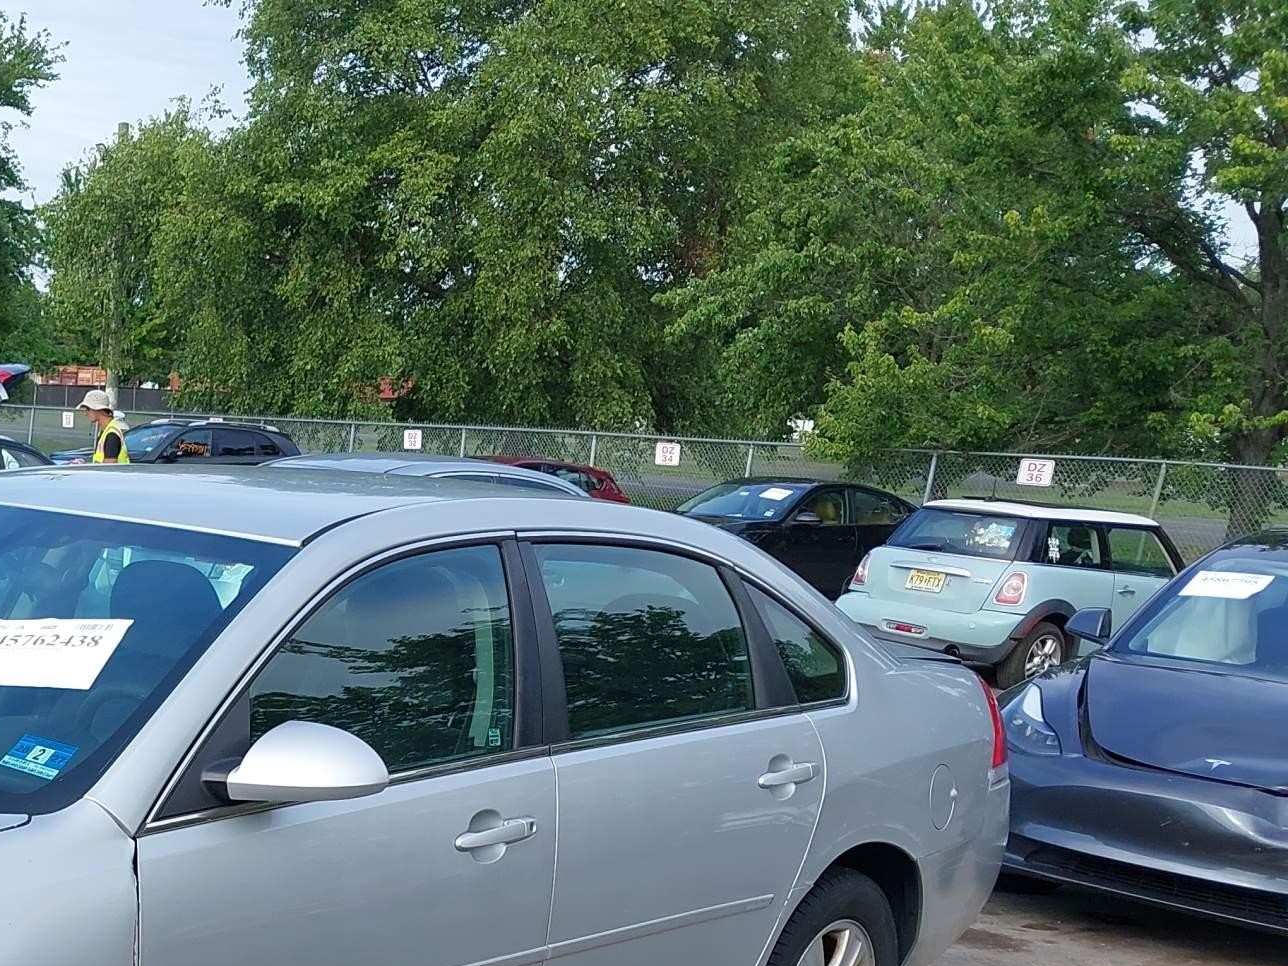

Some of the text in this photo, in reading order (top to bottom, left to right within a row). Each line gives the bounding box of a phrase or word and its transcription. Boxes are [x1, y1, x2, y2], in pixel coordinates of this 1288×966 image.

[661, 446, 677, 455] DZ
[661, 455, 673, 463] 34
[1027, 462, 1048, 473] DZ
[1025, 472, 1043, 483] 36
[31, 748, 47, 761] 2
